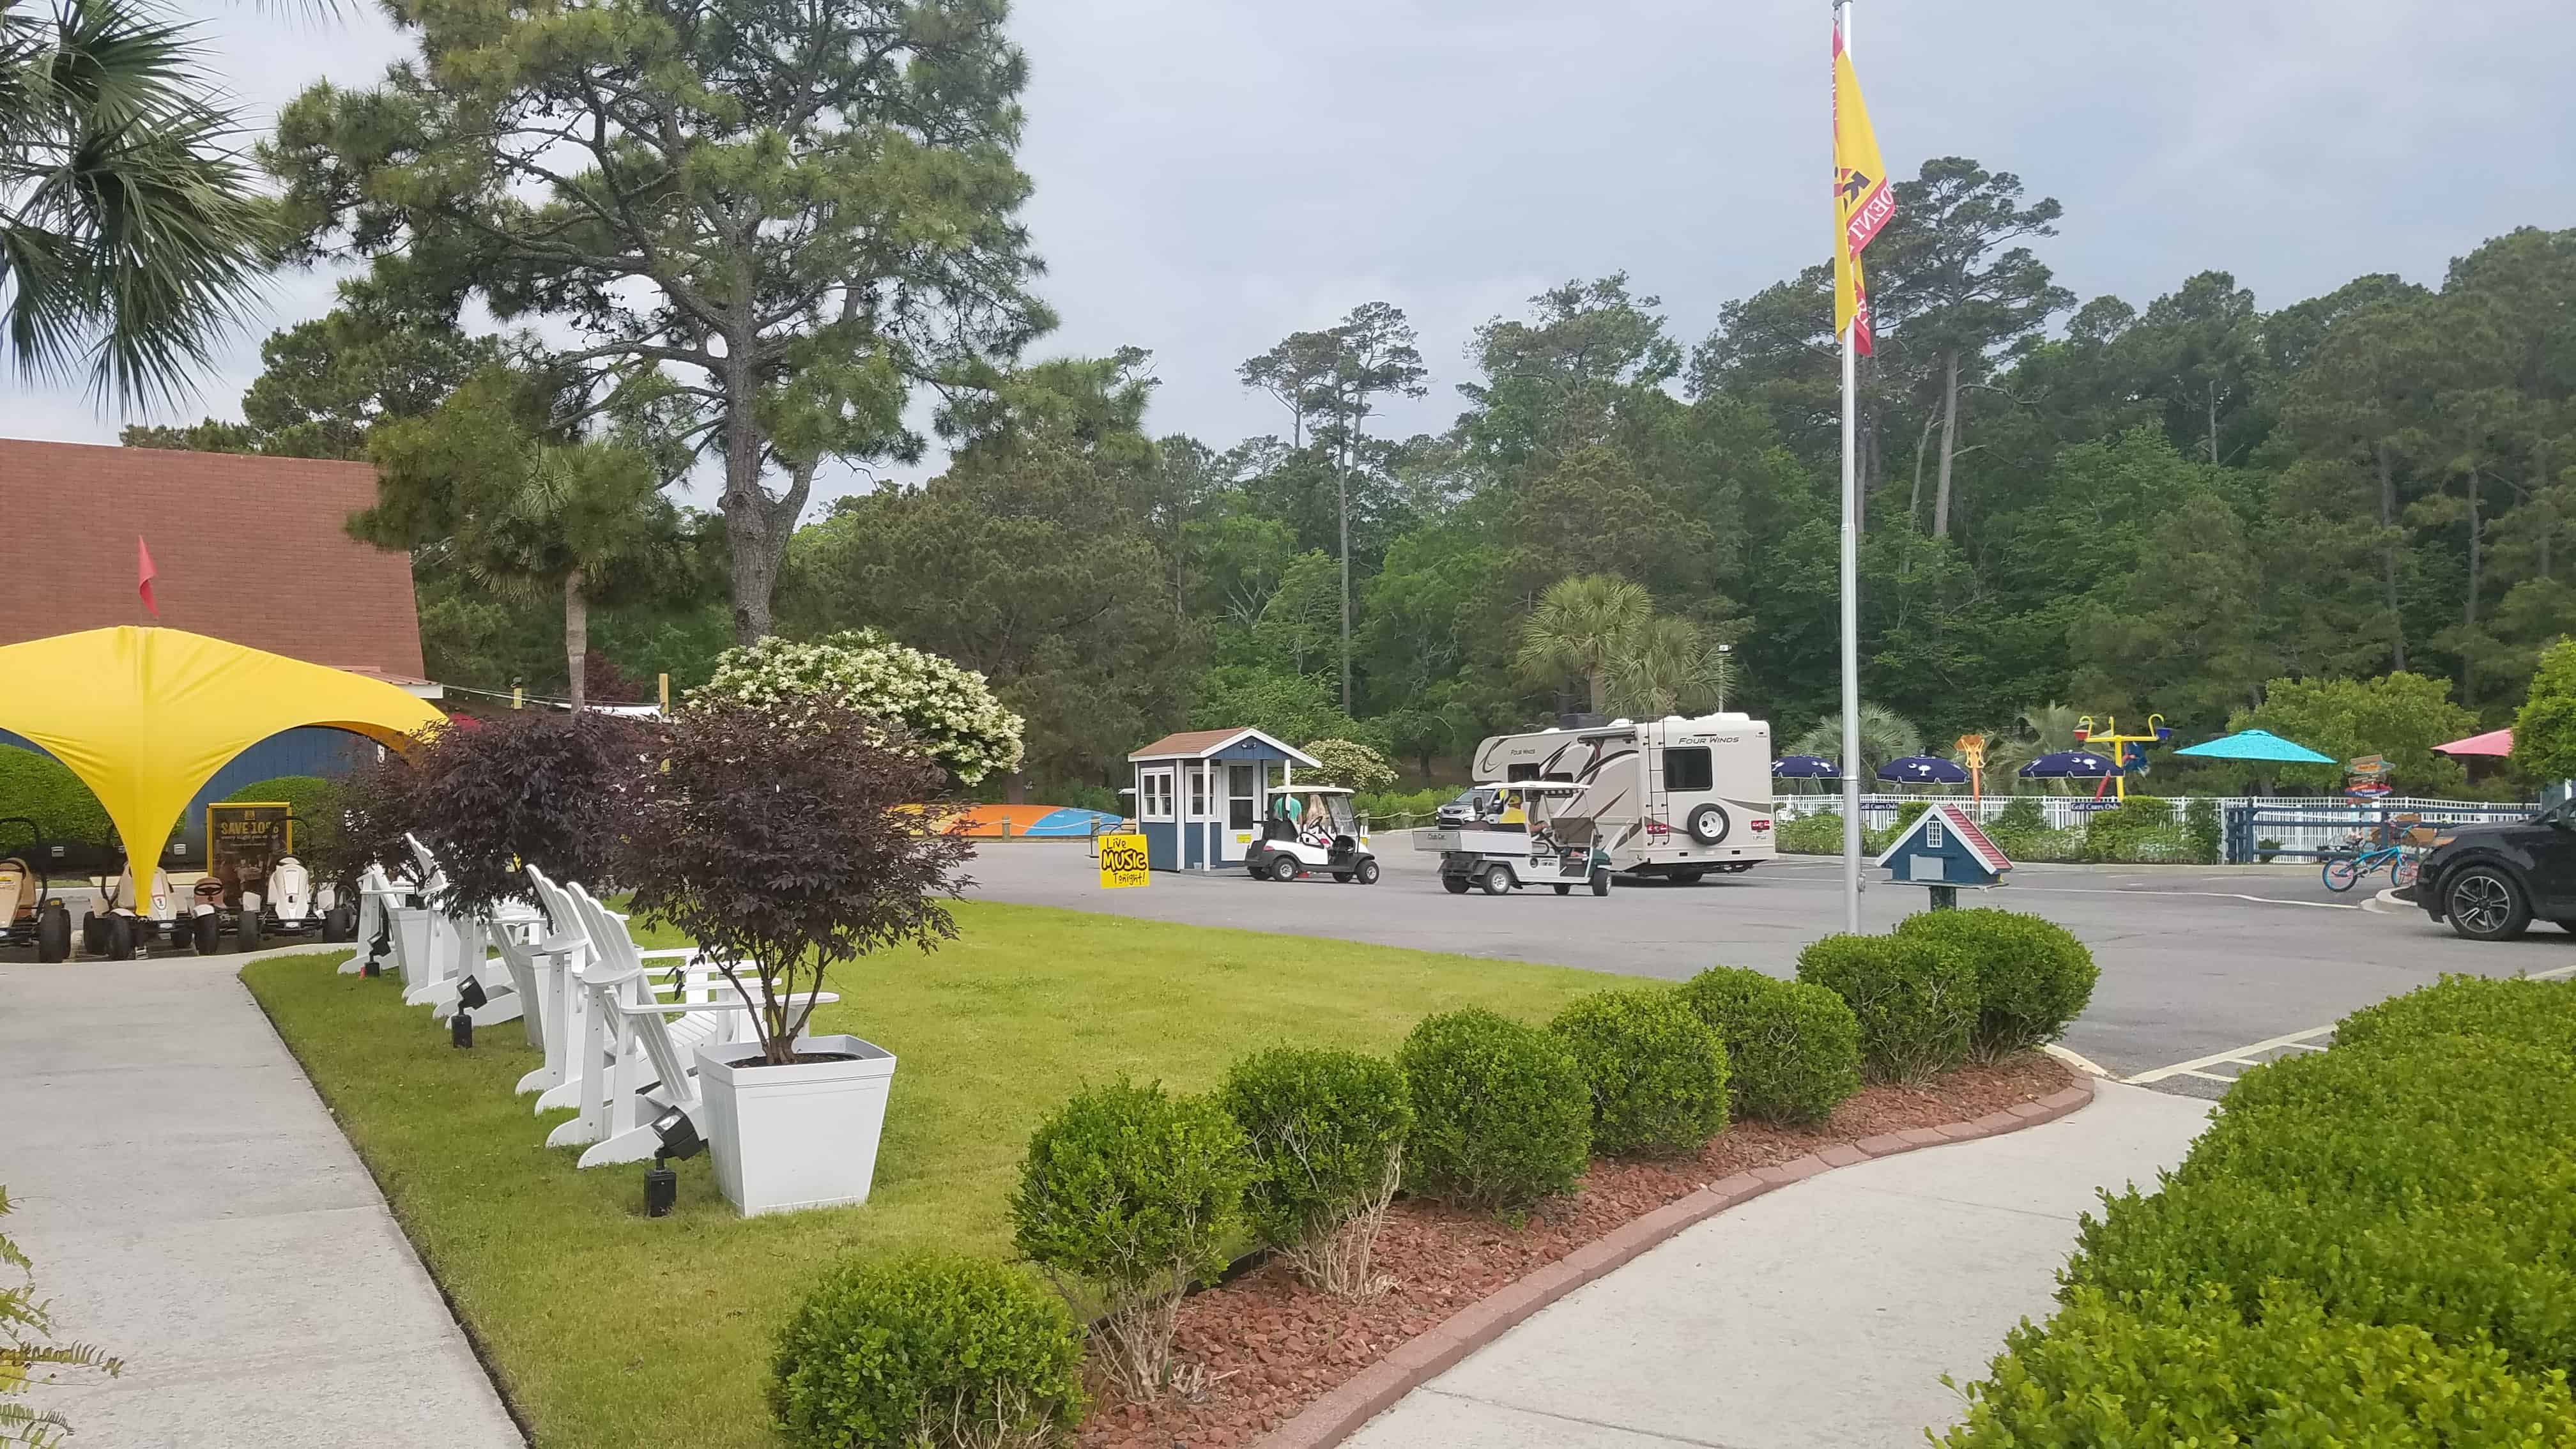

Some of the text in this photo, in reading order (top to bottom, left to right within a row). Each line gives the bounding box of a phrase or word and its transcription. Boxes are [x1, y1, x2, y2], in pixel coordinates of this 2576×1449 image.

[220, 822, 249, 834] SAVE
[1107, 838, 1126, 850] Live
[1101, 848, 1147, 872] MUSIC
[1113, 872, 1146, 885] Tonight!
